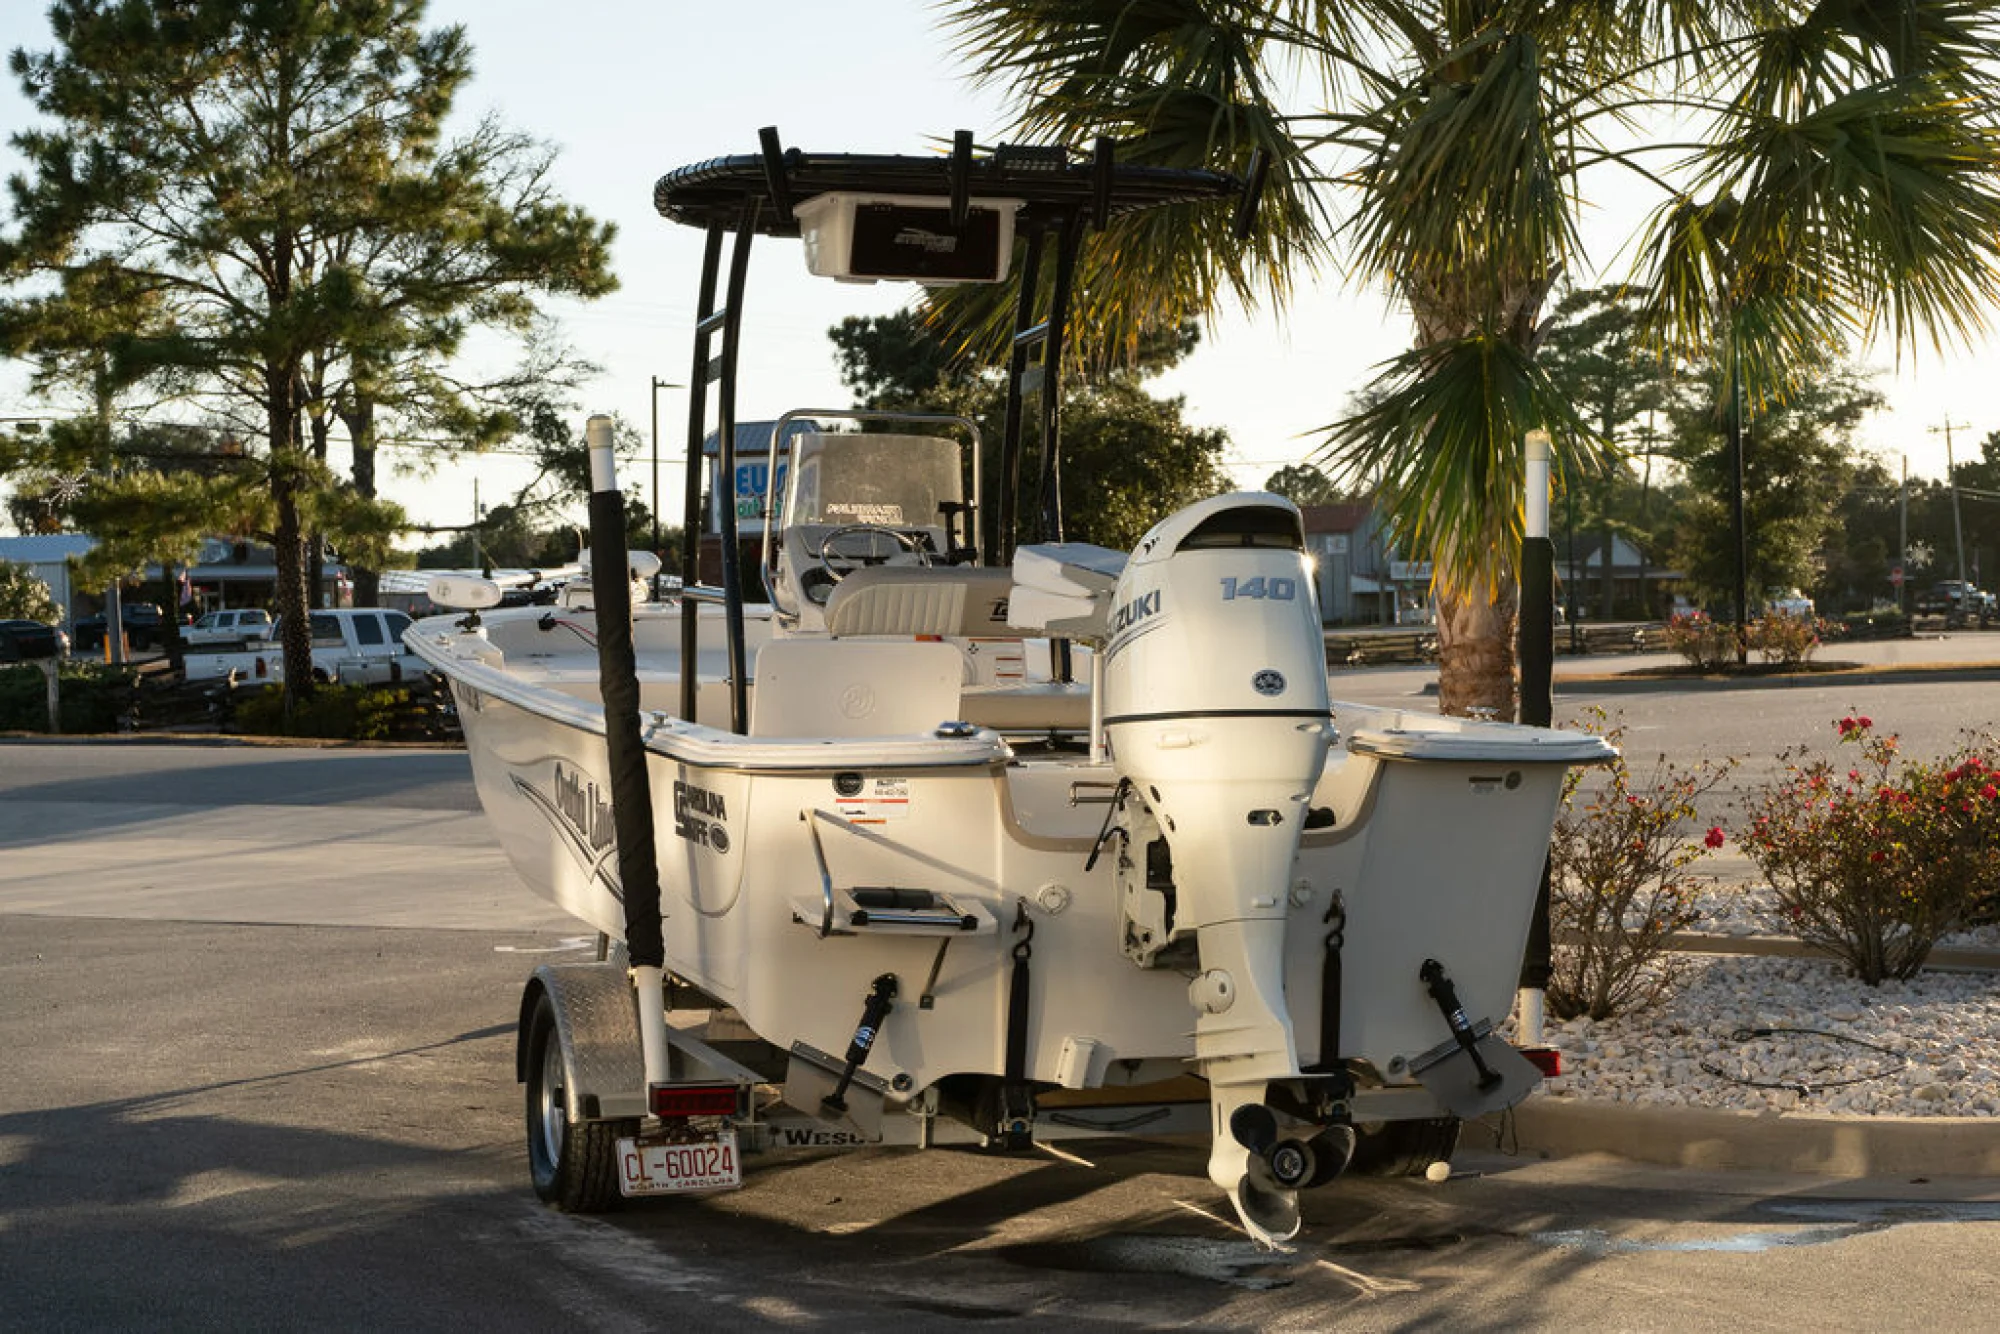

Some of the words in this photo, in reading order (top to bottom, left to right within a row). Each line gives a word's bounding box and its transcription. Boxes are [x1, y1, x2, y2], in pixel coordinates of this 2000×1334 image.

[1220, 576, 1296, 601] 140
[1112, 589, 1161, 635] ZUKI
[624, 1144, 735, 1183] CL-60024
